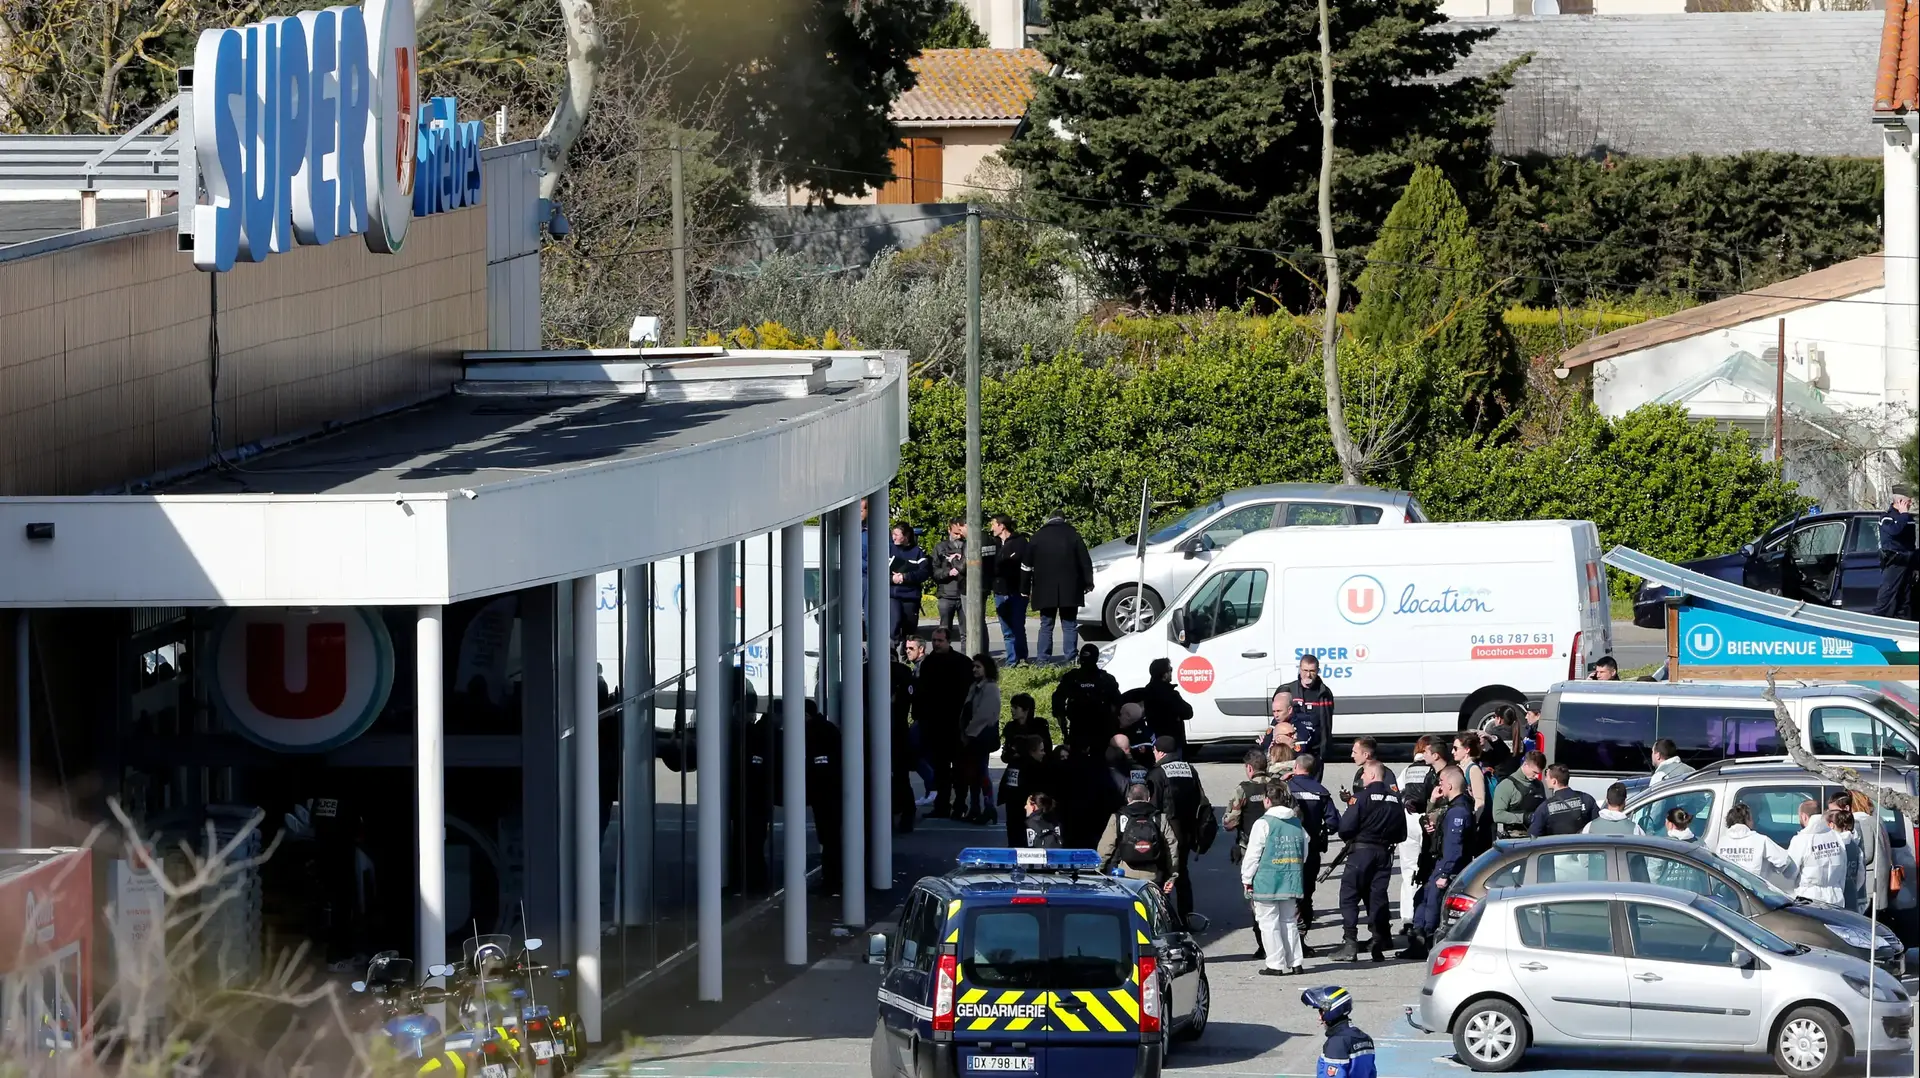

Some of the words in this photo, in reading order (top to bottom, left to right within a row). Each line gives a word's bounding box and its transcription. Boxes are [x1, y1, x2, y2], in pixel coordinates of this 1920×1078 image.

[195, 6, 369, 272] SUPER
[1347, 588, 1374, 614] U
[1393, 583, 1494, 615] location
[1471, 634, 1485, 645] 04
[1489, 634, 1504, 644] 68
[1508, 633, 1529, 644] 787
[1533, 633, 1554, 643] 631
[1694, 633, 1714, 651] U
[1727, 641, 1817, 655] BIENVENUE
[1294, 646, 1348, 661] SUPER
[1355, 648, 1366, 658] U
[1476, 647, 1548, 657] location-u.com
[246, 622, 347, 720] U
[1179, 668, 1213, 677] Comparez
[1194, 674, 1208, 683] prix
[1719, 847, 1755, 855] POLICE
[956, 1003, 1046, 1018] GENDARMERIE
